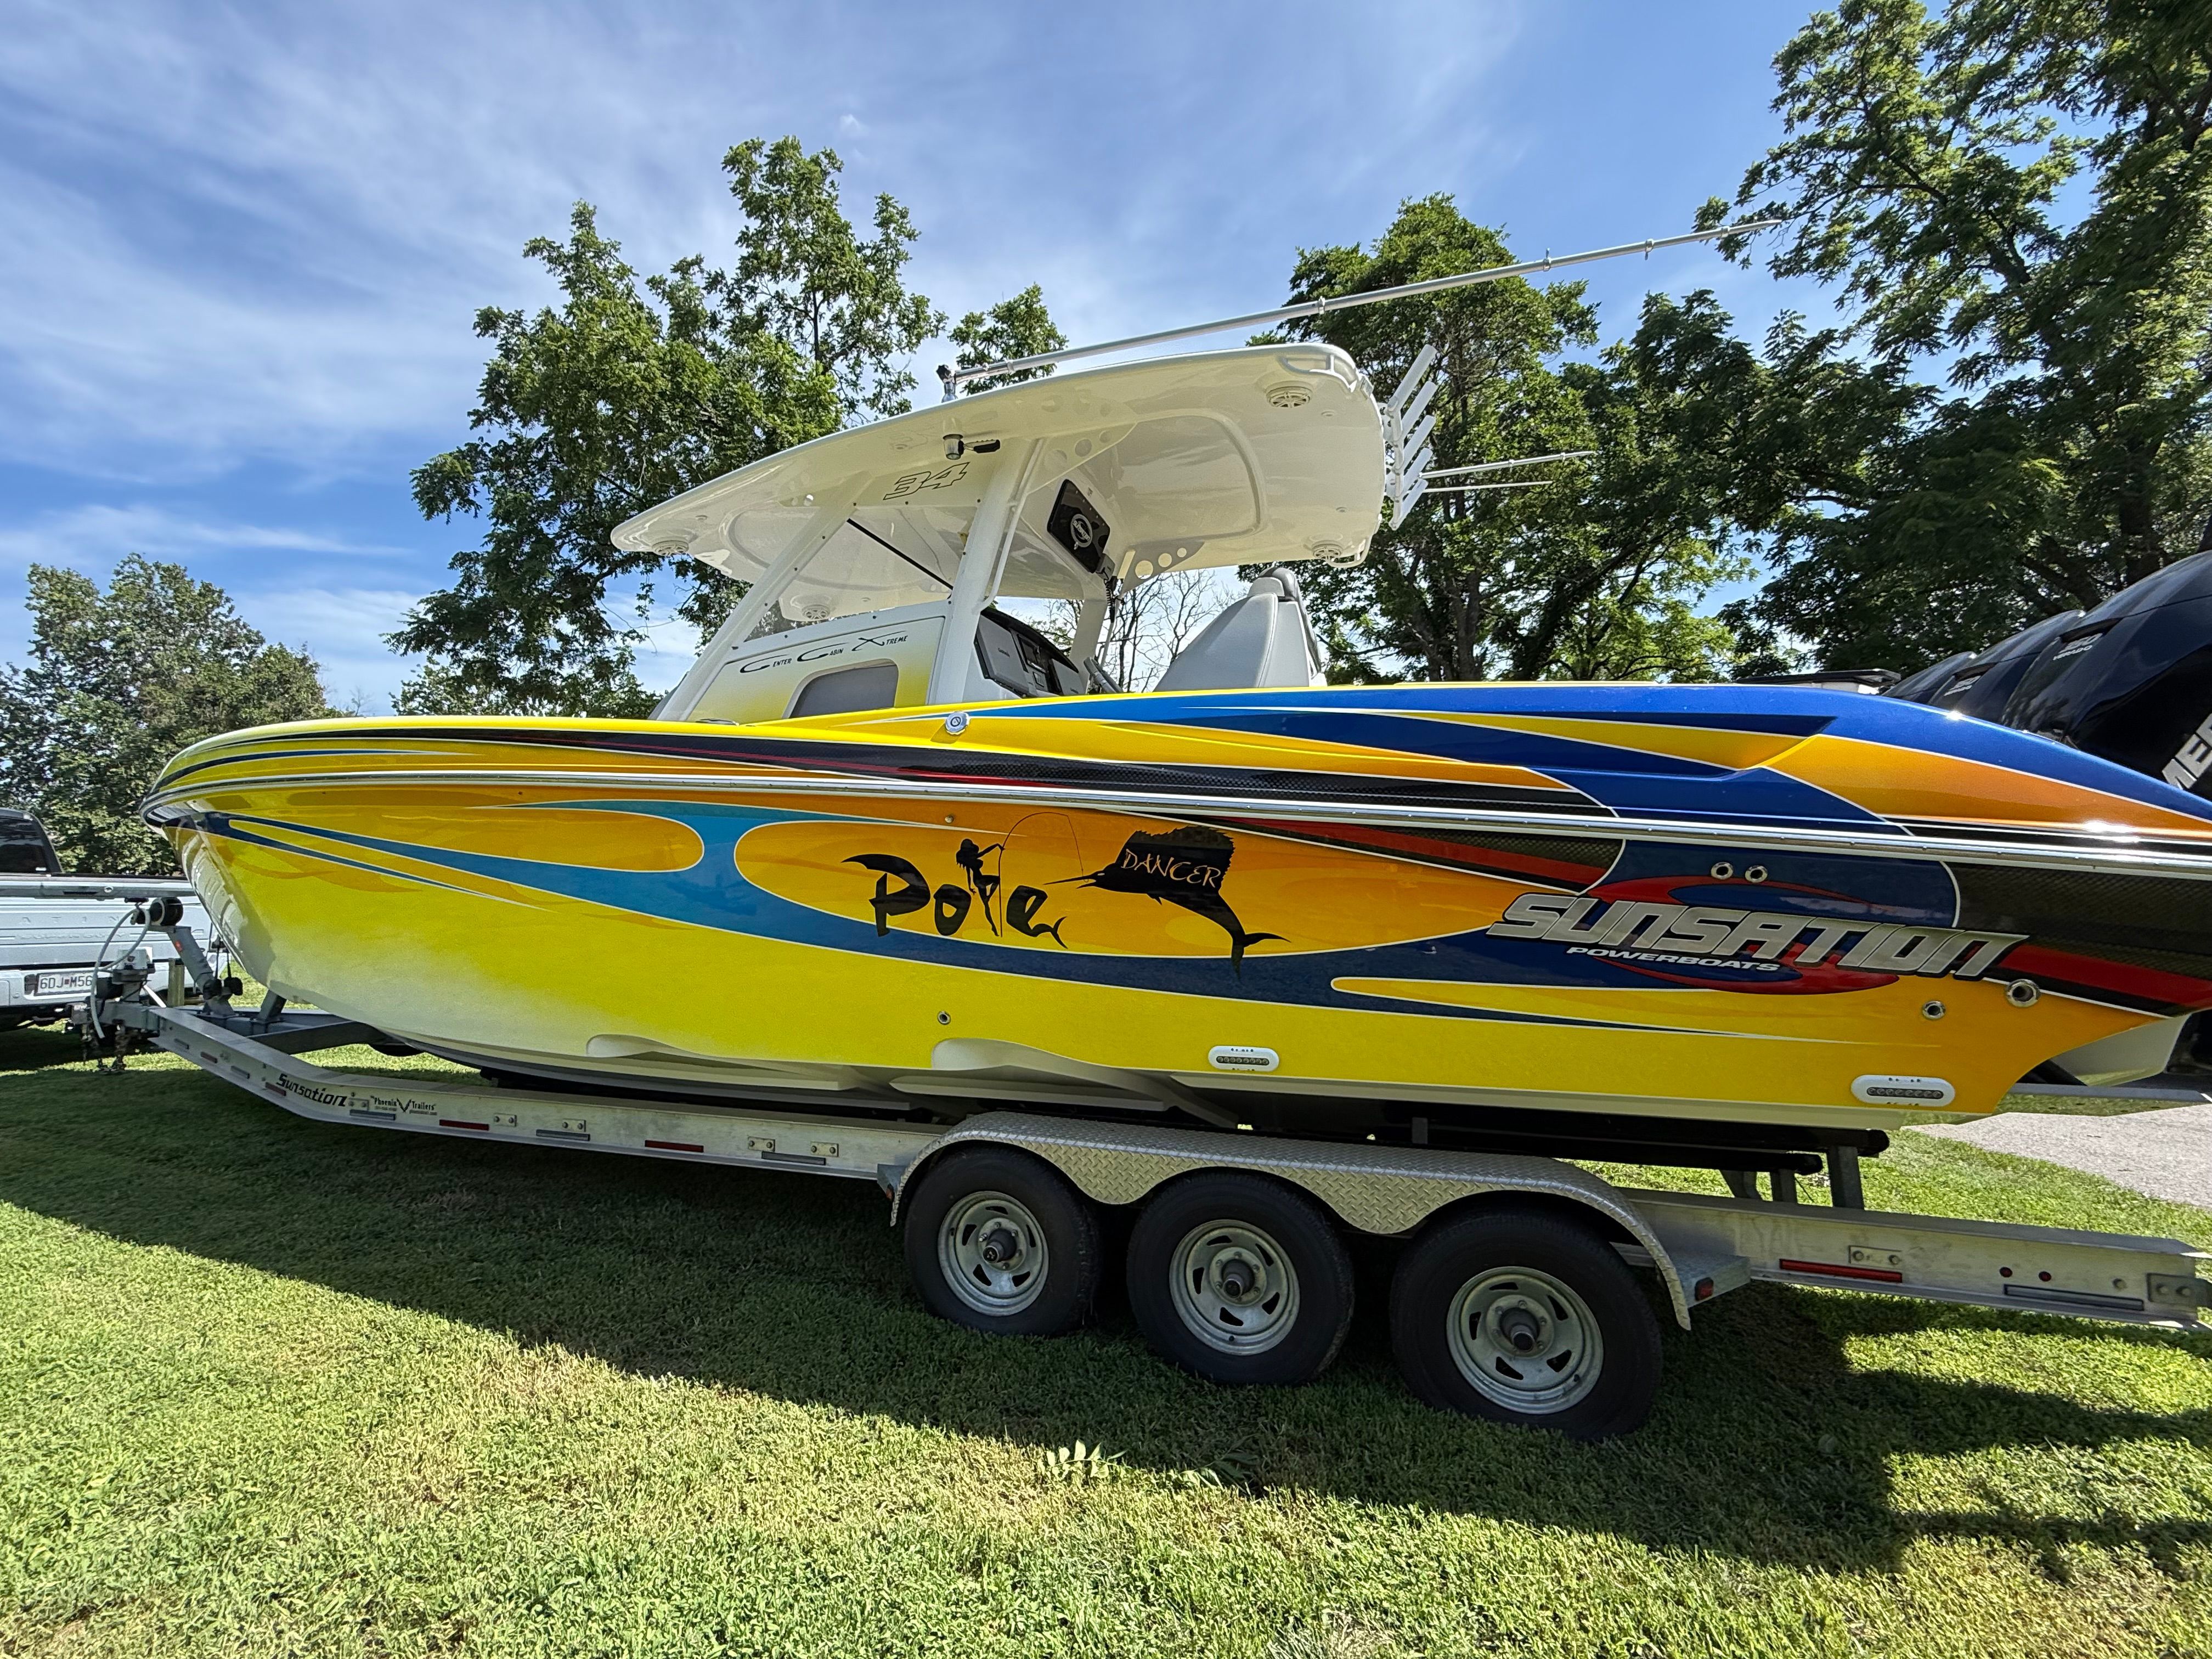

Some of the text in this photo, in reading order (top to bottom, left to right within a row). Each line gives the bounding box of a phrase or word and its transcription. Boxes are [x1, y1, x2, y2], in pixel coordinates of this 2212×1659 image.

[883, 462, 970, 500] 34
[740, 630, 908, 673] CENTER CABIN XTREME
[1122, 848, 1222, 888] DANCER
[1486, 893, 2030, 979] SUNSATION
[1567, 946, 1781, 972] POWERBOATS
[276, 1074, 348, 1107] Sunsation
[412, 1101, 435, 1110] Trailers
